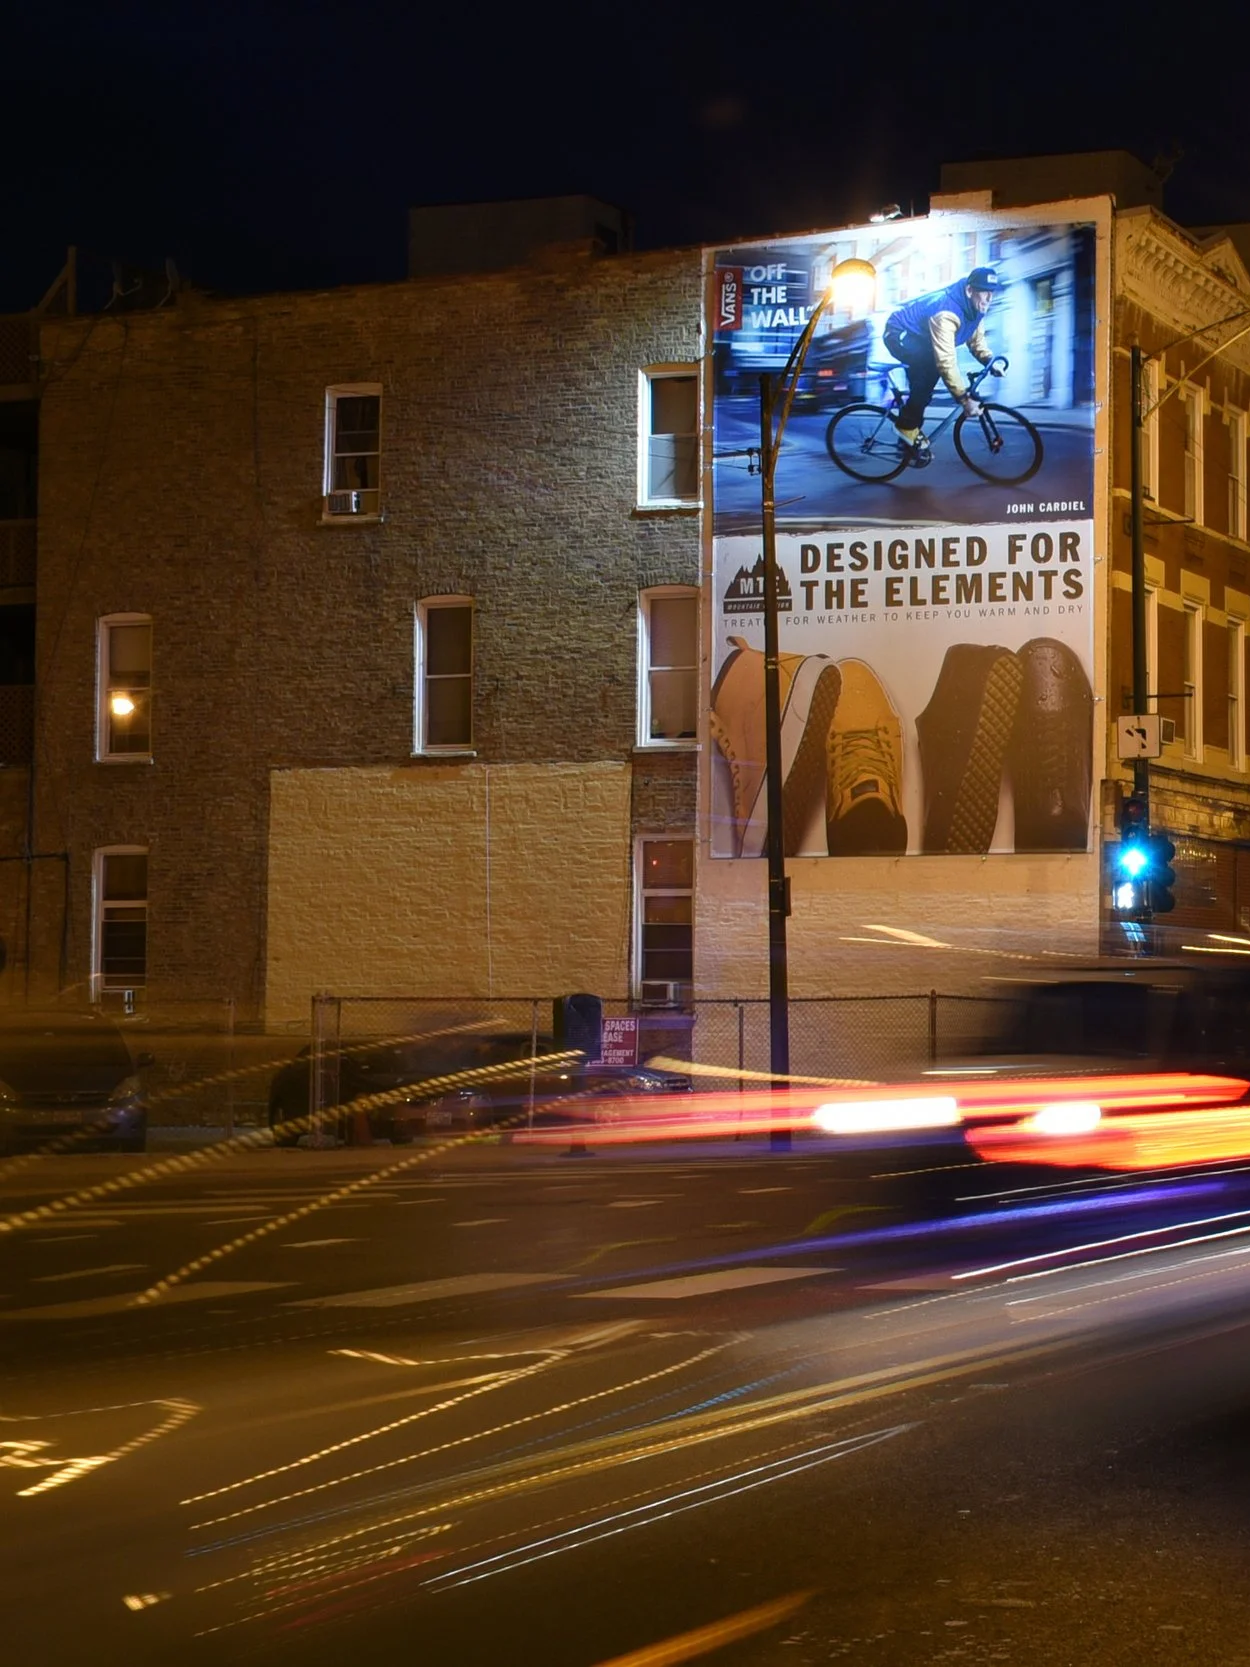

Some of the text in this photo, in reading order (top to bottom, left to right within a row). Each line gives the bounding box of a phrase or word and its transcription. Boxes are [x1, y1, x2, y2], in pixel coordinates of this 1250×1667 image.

[750, 286, 788, 305] THE
[1006, 501, 1086, 514] JOHN CARDIEL
[800, 531, 1081, 574] DESIGNED FOR
[800, 568, 1084, 611] THE ELEMENTS
[786, 616, 809, 626] FOR
[817, 613, 876, 623] WEATHER
[884, 612, 898, 622] TO
[906, 611, 939, 620] KEEP
[947, 609, 971, 619] YOU
[979, 607, 1016, 617] WARM
[1024, 606, 1050, 615] AND
[1058, 605, 1083, 614] DRY
[605, 1020, 635, 1031] SPACES
